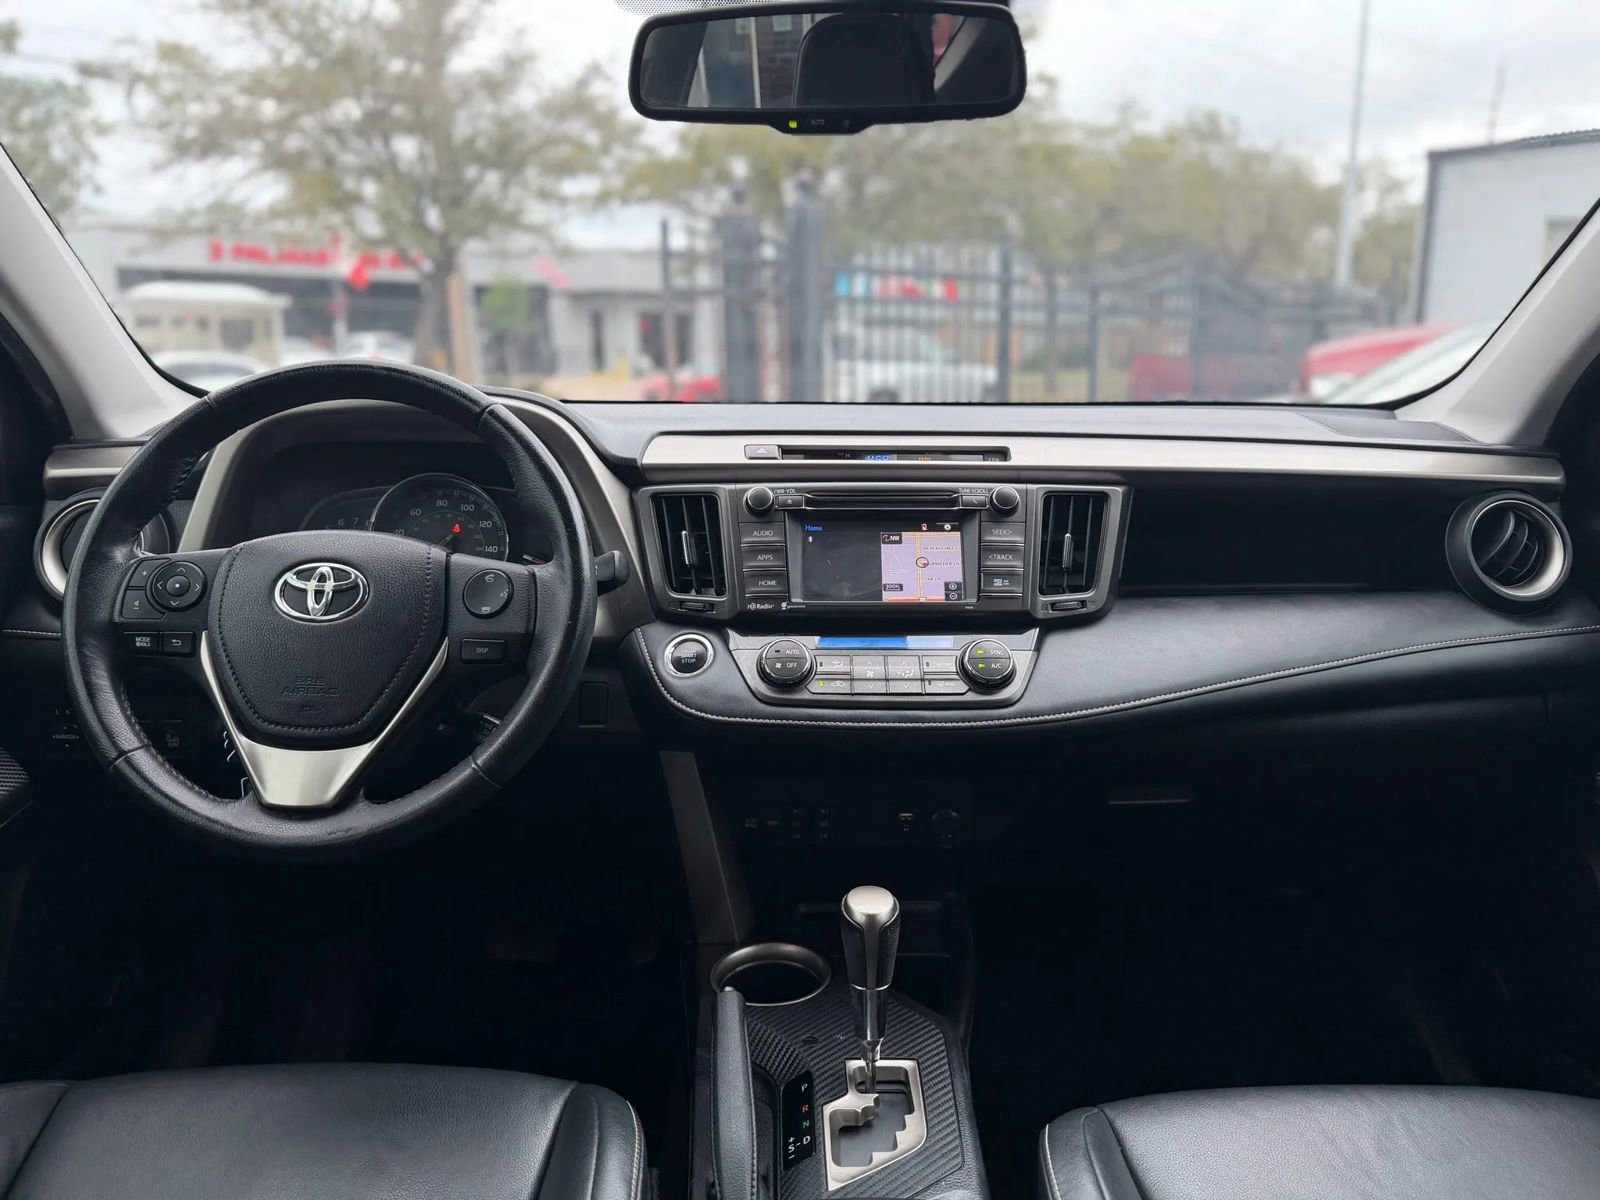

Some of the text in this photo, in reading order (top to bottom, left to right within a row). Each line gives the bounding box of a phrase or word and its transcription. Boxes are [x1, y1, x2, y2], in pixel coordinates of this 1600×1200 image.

[436, 499, 449, 508] 80
[460, 504, 475, 512] 100
[409, 508, 422, 516] 60
[479, 520, 493, 528] 120
[484, 545, 499, 554] 140
[281, 686, 338, 697] AIRBAG
[801, 1083, 808, 1092] P
[802, 1104, 809, 1113] R
[802, 1120, 810, 1129] N
